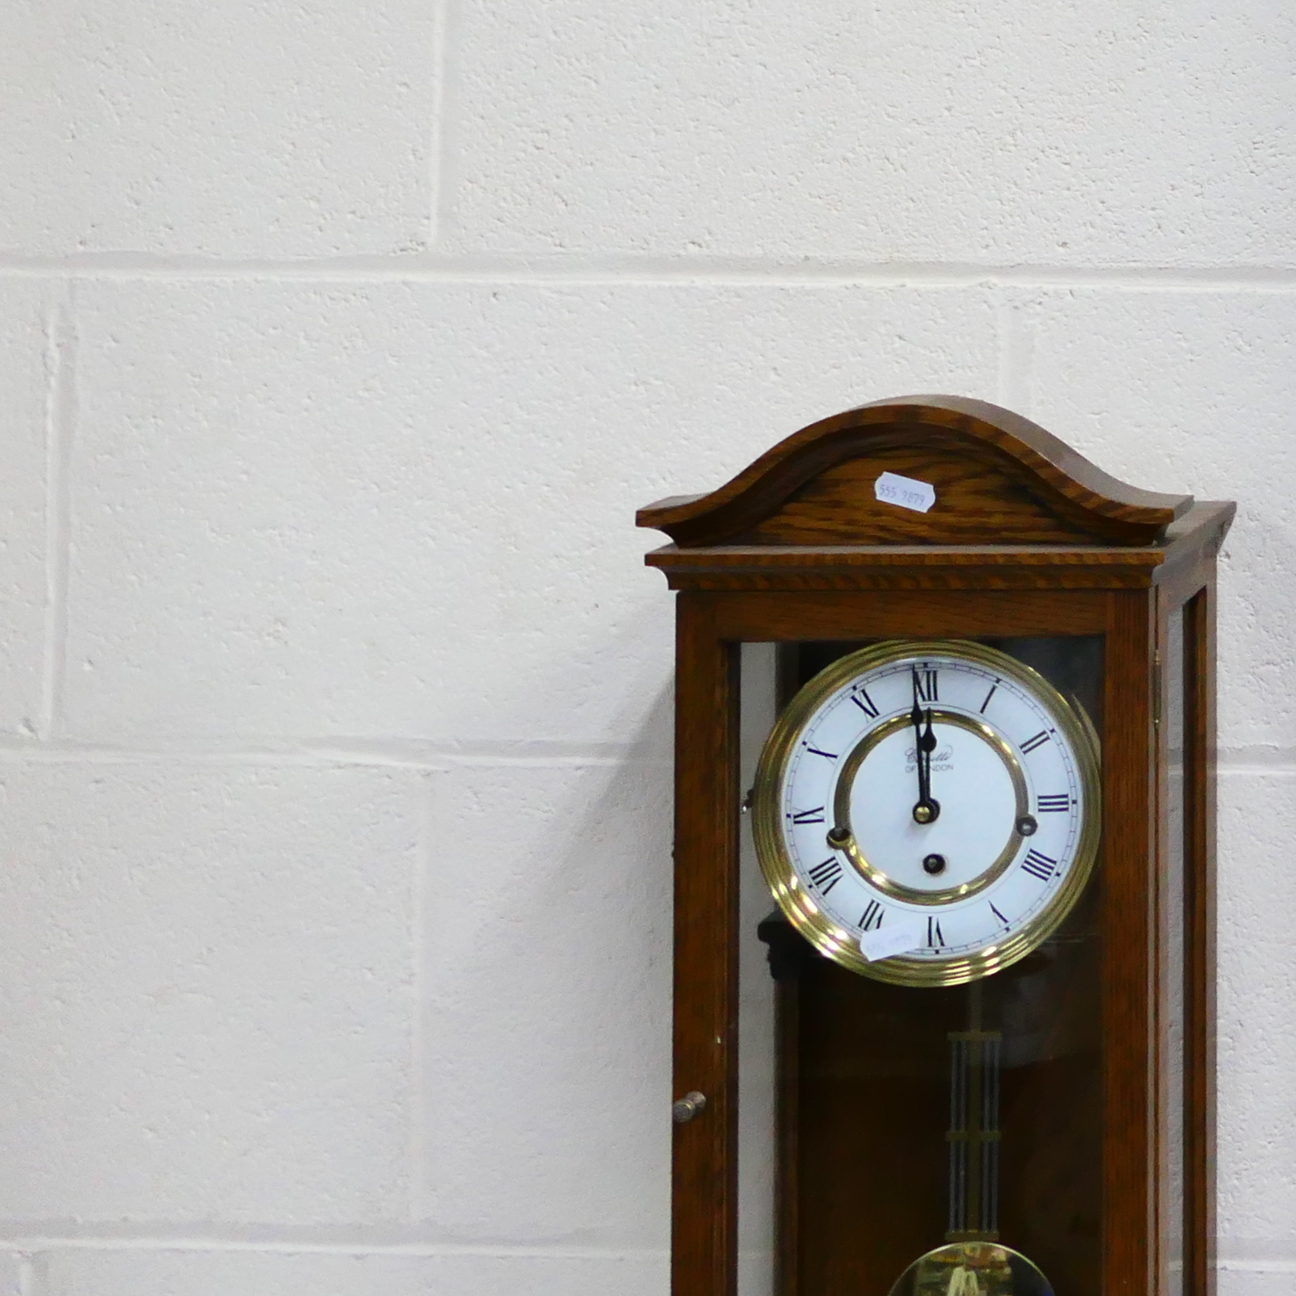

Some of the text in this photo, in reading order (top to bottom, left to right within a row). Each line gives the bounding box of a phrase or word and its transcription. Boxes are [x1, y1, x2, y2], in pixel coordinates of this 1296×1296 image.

[879, 484, 897, 499] 555
[850, 688, 880, 724] XI
[979, 684, 998, 714] I
[1019, 730, 1052, 755] II
[1037, 794, 1069, 813] III
[808, 856, 844, 896] VIII
[988, 899, 1010, 928] V
[928, 916, 945, 947] VI
